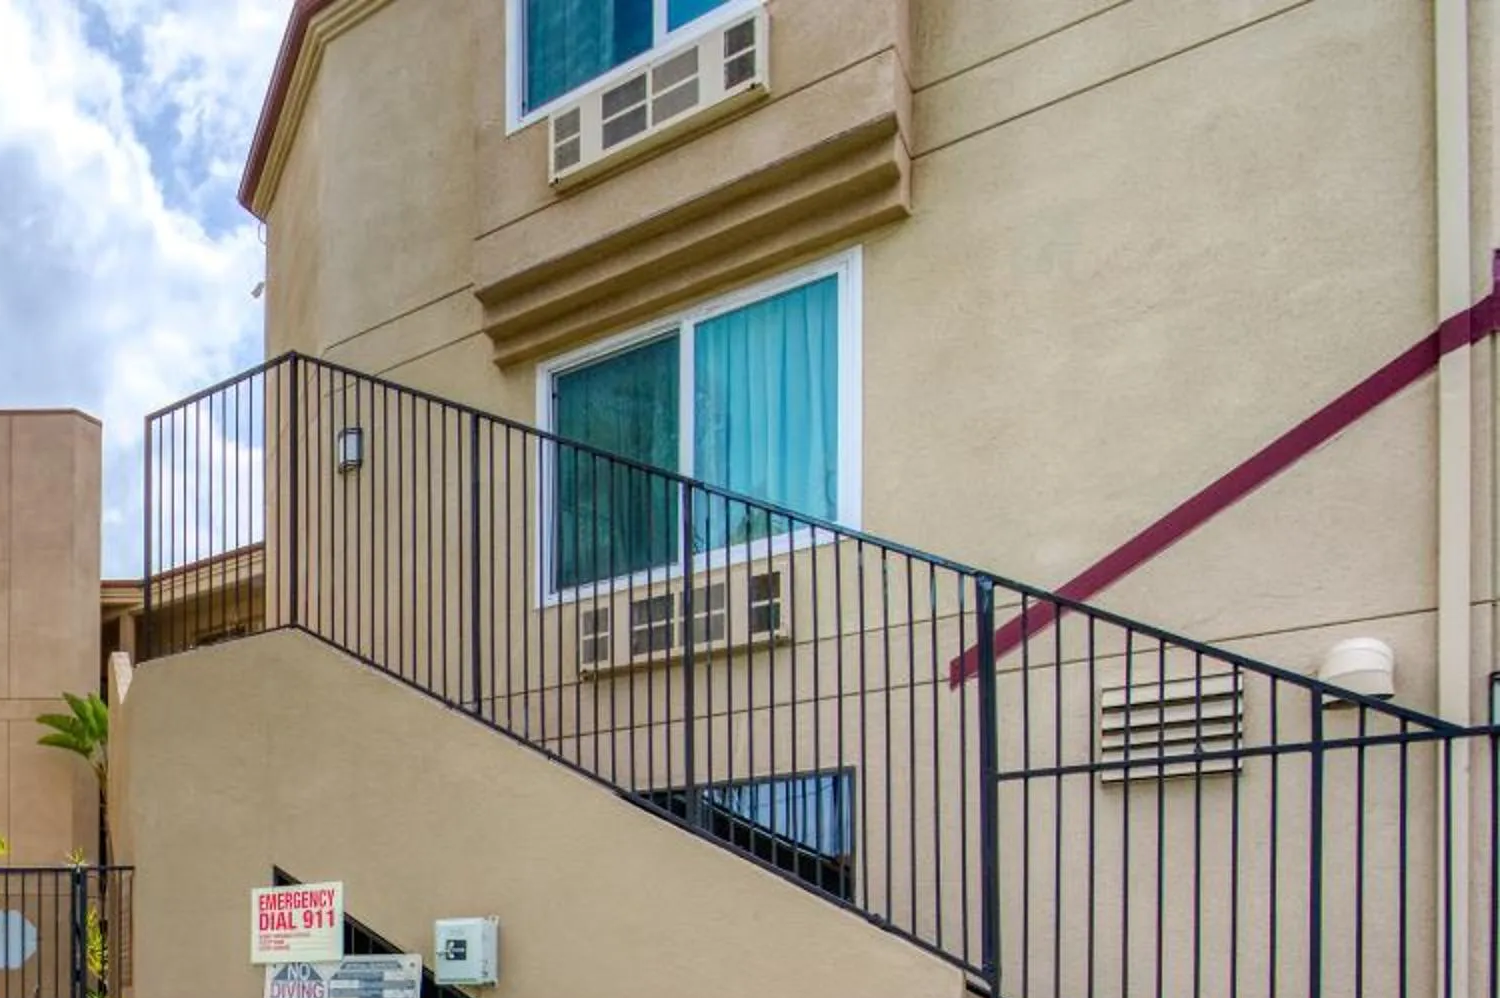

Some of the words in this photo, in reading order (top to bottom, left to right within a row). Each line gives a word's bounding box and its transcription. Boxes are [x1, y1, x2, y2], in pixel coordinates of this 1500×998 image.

[259, 888, 335, 911] EMERGENCY
[259, 911, 297, 931] DIAL
[303, 909, 335, 929] 911
[287, 963, 311, 980] NO
